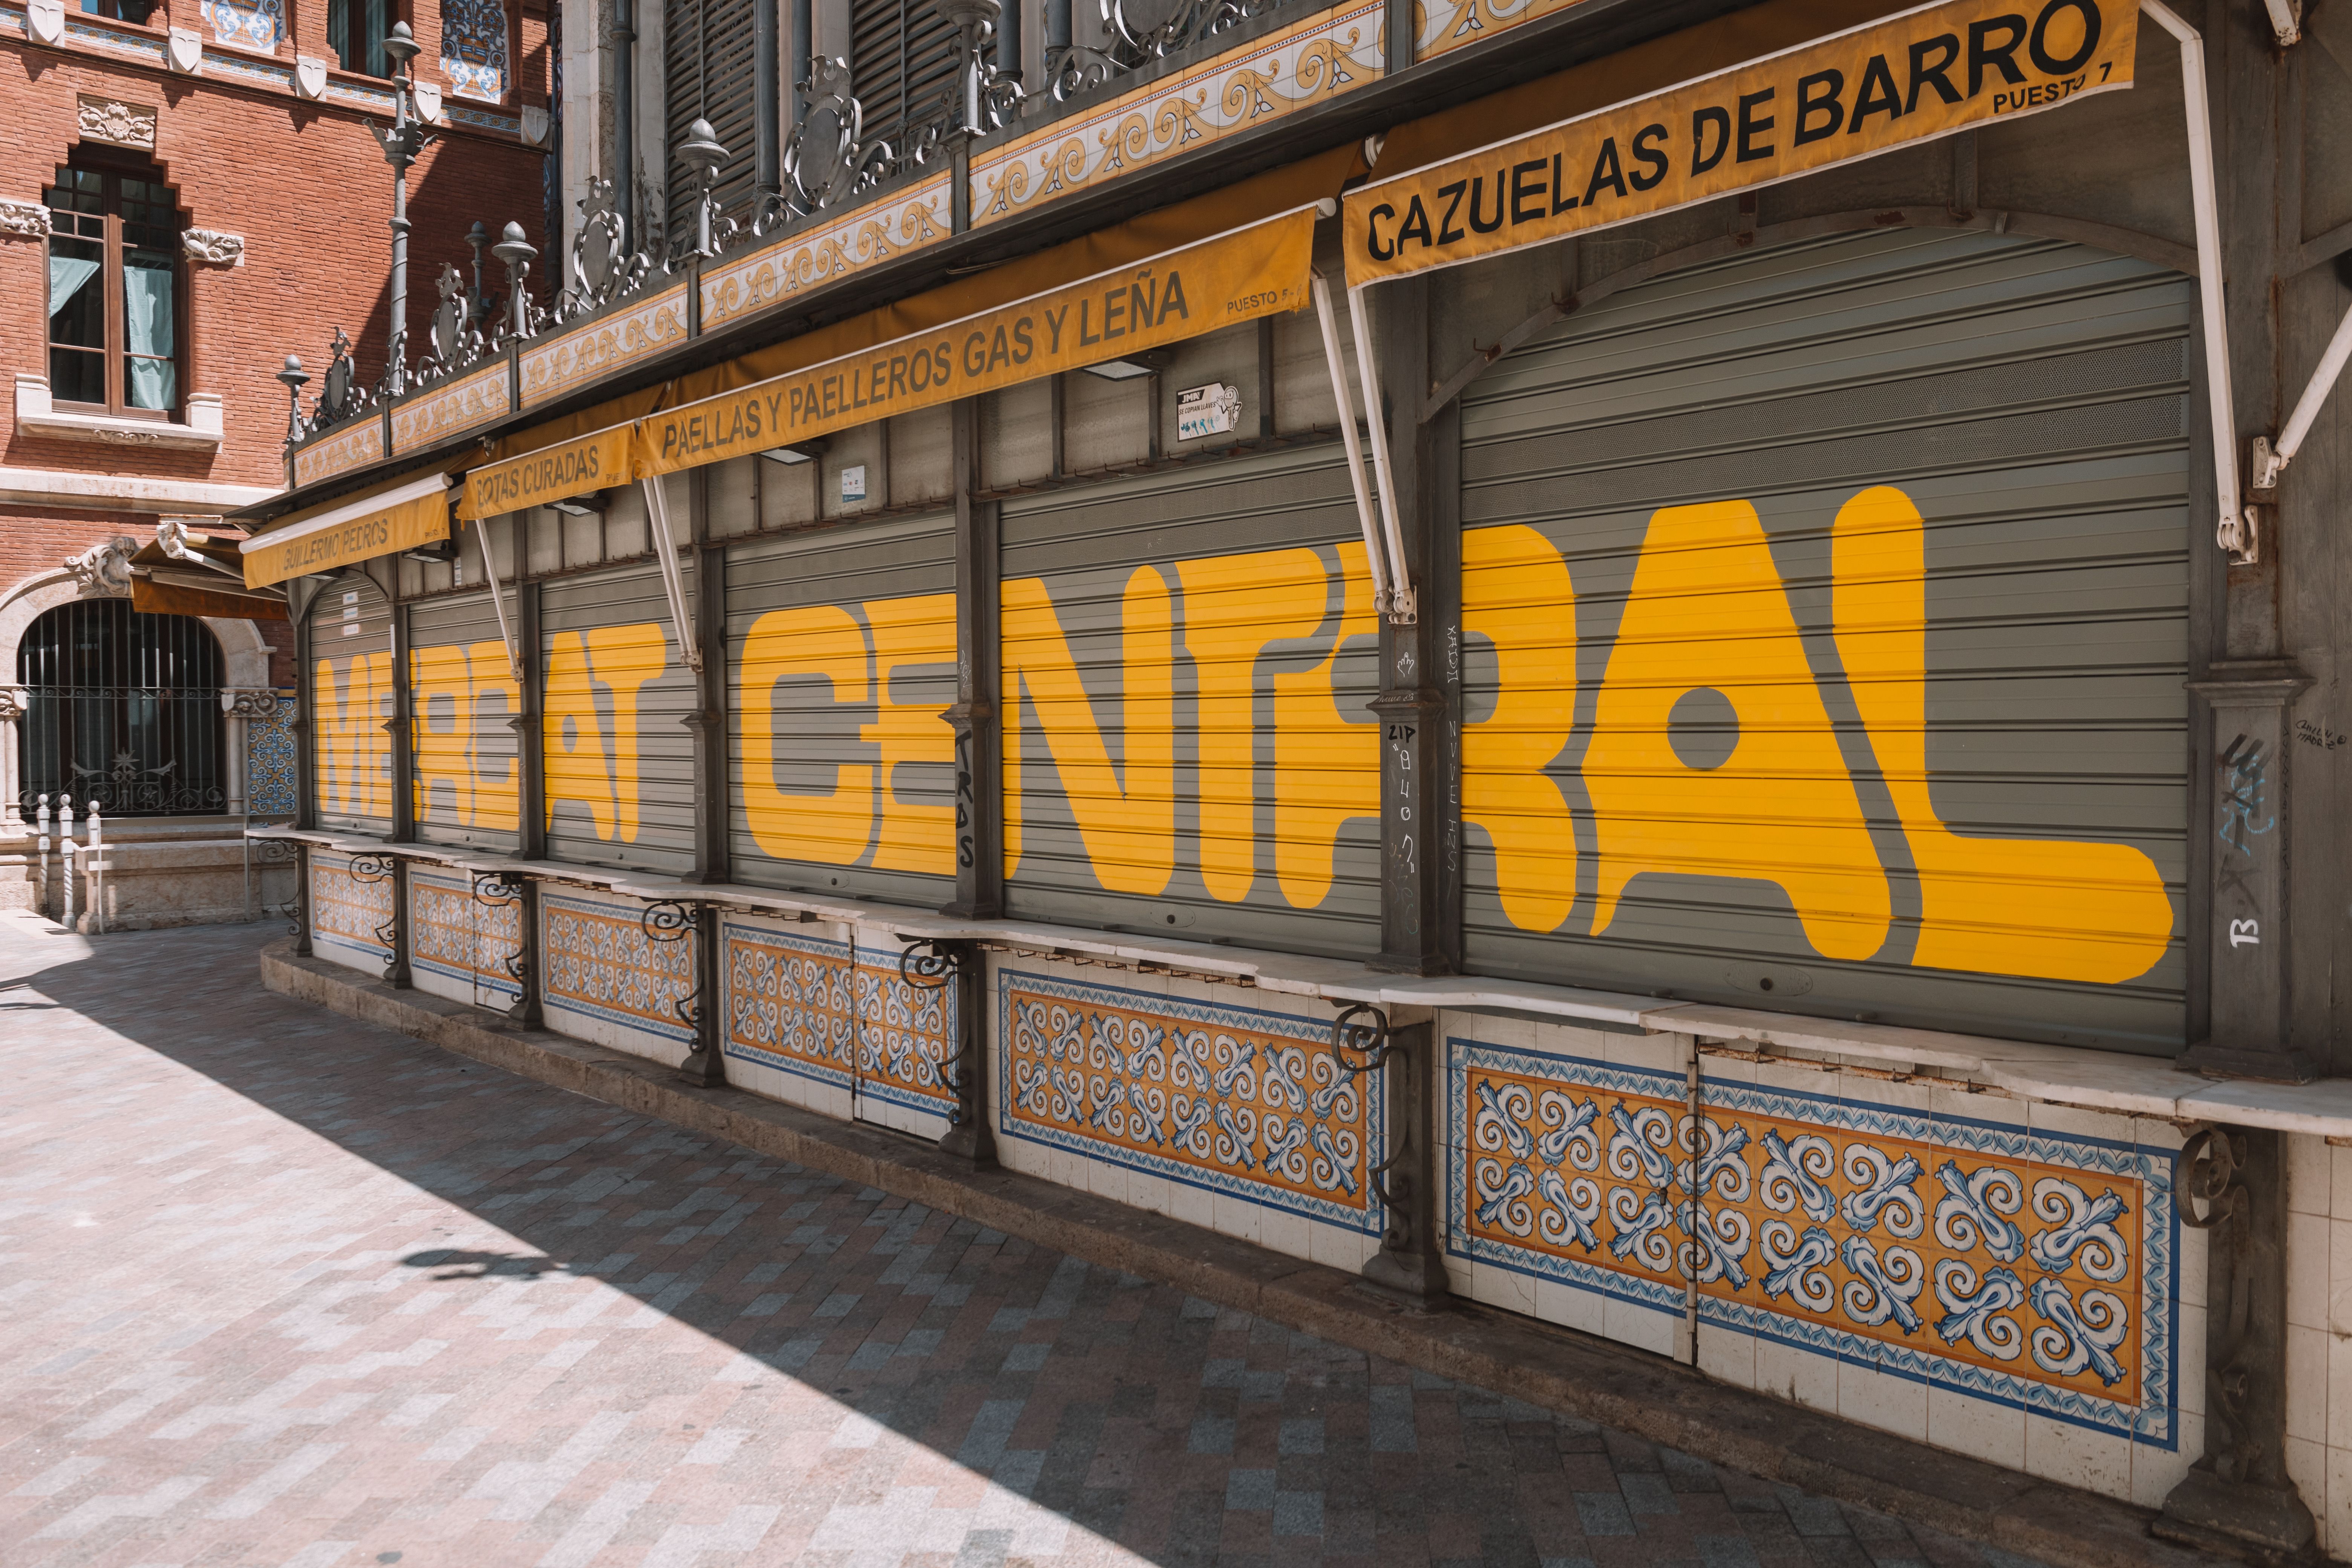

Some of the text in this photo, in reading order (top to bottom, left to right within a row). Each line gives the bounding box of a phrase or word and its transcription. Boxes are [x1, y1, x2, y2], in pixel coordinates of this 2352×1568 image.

[1994, 61, 2113, 113] PUESTO 7
[1368, 0, 2102, 261] CAZUELAS DE BARRO
[1227, 290, 1277, 315] PUESTO
[662, 268, 1189, 459] PAELLAS Y PAELLEROS GAS Y LEÑA
[1182, 391, 1200, 403] JMA
[1185, 404, 1200, 414] COPIAN
[1200, 401, 1216, 410] LLAVES
[476, 445, 599, 508] BOTAS CURADAS
[283, 518, 388, 571] GUILLERMO PEDROS
[317, 623, 665, 843] MERCAT
[745, 485, 2174, 984] CENTRAL
[1388, 725, 1416, 743] ZIP
